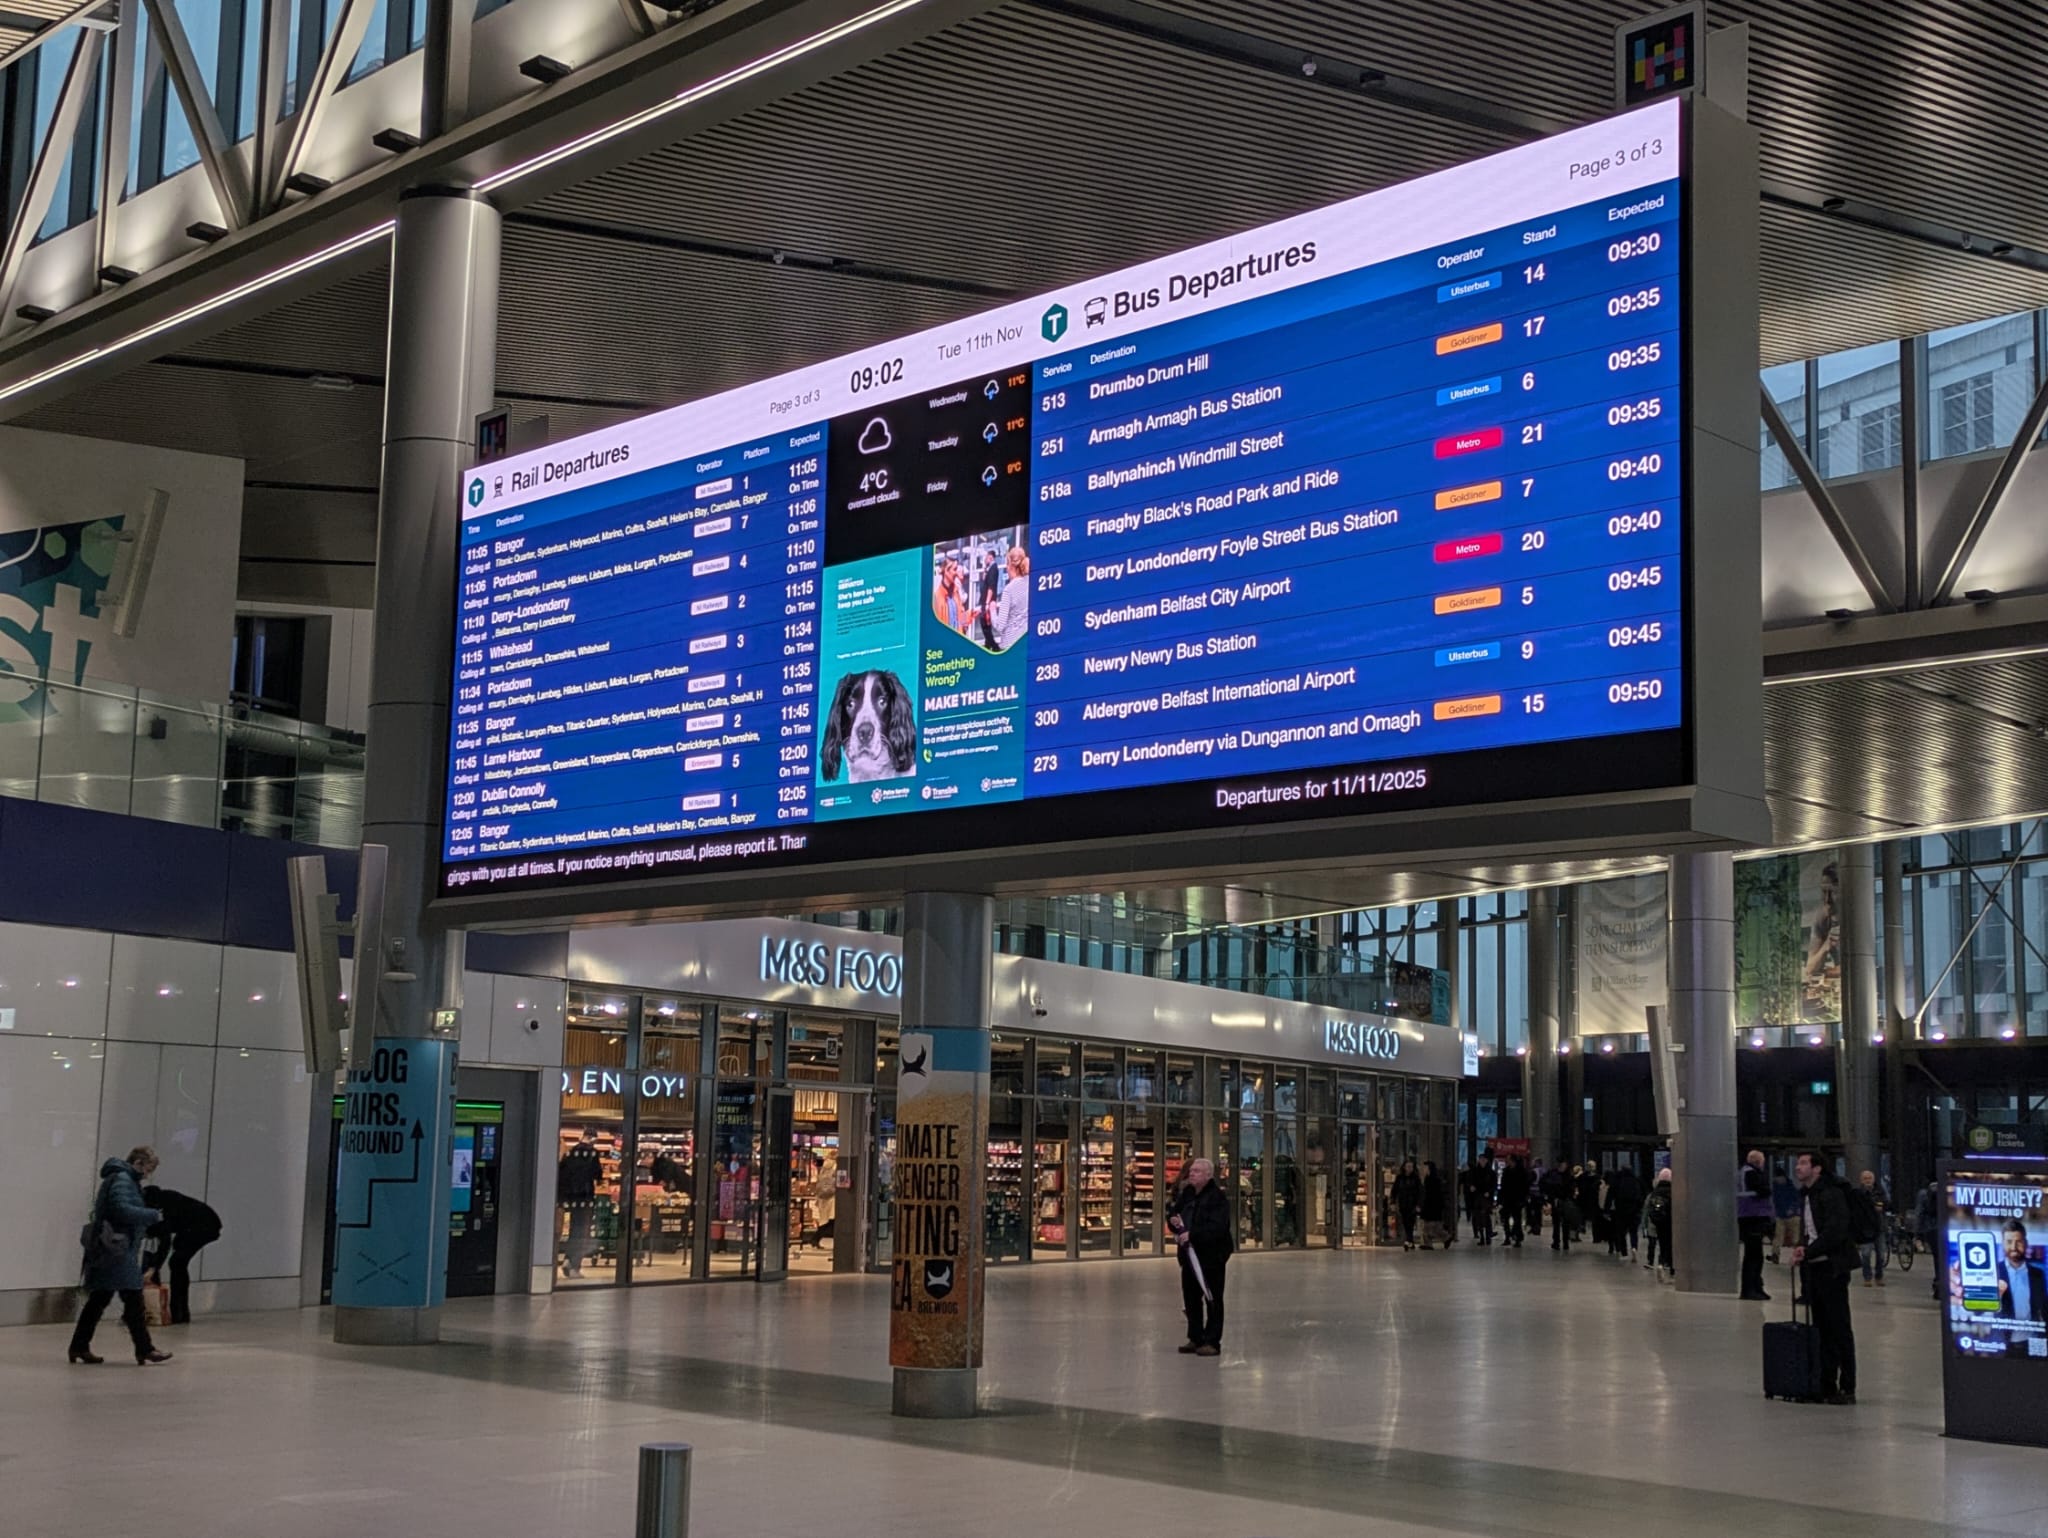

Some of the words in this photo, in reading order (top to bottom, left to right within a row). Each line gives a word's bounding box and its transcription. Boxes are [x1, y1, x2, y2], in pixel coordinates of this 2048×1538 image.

[1570, 158, 1610, 179] Page
[1616, 150, 1625, 166] 3
[1631, 142, 1647, 161] of
[1652, 139, 1661, 155] 3
[1043, 363, 1072, 377] Service
[1090, 345, 1136, 364] Destination
[1437, 248, 1484, 268] Operator
[1523, 225, 1556, 244] Stand
[1609, 195, 1664, 221] Expected
[1114, 288, 1159, 317] Bus
[1169, 242, 1316, 302] Departures
[938, 345, 961, 360] Tue
[966, 332, 993, 352] 11th
[997, 325, 1023, 344] Nov
[1042, 392, 1065, 411] 513
[1090, 374, 1145, 399] Drumbo
[1147, 364, 1183, 384] Drum
[1187, 354, 1208, 373] Hill
[1451, 281, 1489, 296] Ulsterbus
[1524, 263, 1544, 283] 14
[1609, 233, 1660, 262] 09:30
[851, 358, 904, 394] 09:02
[929, 391, 967, 409] Wednesday
[1041, 437, 1063, 456] 251
[1088, 419, 1142, 445] Armagh
[1145, 405, 1197, 431] Armagh
[1201, 400, 1228, 417] Bus
[1231, 386, 1281, 409] Station
[1451, 333, 1487, 347] Goldliner
[1524, 316, 1544, 336] 17
[1608, 287, 1660, 316] 09:35
[770, 400, 792, 413] Page
[795, 395, 800, 407] 3
[803, 391, 812, 404] of
[814, 389, 820, 401] 3
[1041, 482, 1071, 501] 518a
[1088, 457, 1175, 490] Ballynahinch
[1178, 441, 1236, 469] Windmill
[1240, 431, 1283, 455] Street
[1450, 385, 1489, 399] Ulsterbus
[1522, 372, 1534, 390] 6
[1608, 343, 1660, 370] 09:35
[512, 466, 538, 491] Rail
[544, 445, 629, 482] Departures
[928, 436, 959, 451] Thursday
[1039, 527, 1070, 546] 650a
[1087, 513, 1141, 536] Finaghy
[1144, 501, 1192, 524] Black's
[1196, 490, 1233, 513] Road
[1237, 484, 1269, 504] Park
[1272, 476, 1300, 497] and
[1304, 469, 1339, 490] Ride
[1457, 439, 1480, 449] Metro
[1522, 423, 1542, 444] 21
[1608, 398, 1660, 425] 09:35
[495, 538, 524, 554] Bangor
[790, 459, 817, 477] 11:05
[848, 495, 876, 511] overcast
[877, 490, 900, 504] clouds
[927, 481, 948, 494] Friday
[493, 569, 537, 588] Portadown
[789, 499, 816, 517] 11:06
[1038, 573, 1062, 591] 212
[1087, 563, 1124, 581] Derry
[1127, 545, 1217, 574] Londonderry
[1221, 535, 1259, 556] Foyle
[1262, 525, 1305, 547] Street
[1310, 521, 1339, 538] Bus
[1343, 510, 1397, 531] Station
[1450, 490, 1486, 503] Goldliner
[1522, 478, 1533, 497] 7
[1608, 454, 1660, 480] 09:40
[491, 598, 570, 624] Derry-Londonderry
[787, 539, 814, 557] 11:10
[1037, 618, 1060, 636] 600
[1085, 604, 1157, 629] Sydenham
[1161, 592, 1207, 614] Belfast
[1210, 588, 1238, 606] City
[1241, 577, 1291, 600] Airport
[1456, 544, 1480, 554] Metro
[1522, 531, 1544, 551] 20
[1608, 510, 1660, 535] 09:40
[490, 639, 533, 659] Whitehead
[786, 580, 813, 598] 11:15
[1036, 663, 1059, 681] 238
[1085, 656, 1128, 674] Newry
[1131, 649, 1173, 666] Newry
[1177, 643, 1203, 659] Bus
[1206, 634, 1256, 654] Station
[1449, 597, 1486, 608] Goldliner
[1522, 586, 1533, 605] 5
[1608, 566, 1661, 591] 09:45
[926, 650, 943, 661] See
[926, 657, 975, 675] Something
[926, 673, 961, 688] Wrong?
[1035, 709, 1058, 726] 300
[1083, 698, 1159, 720] Aldergrove
[1162, 688, 1208, 709] Belfast
[1213, 674, 1299, 702] International
[1303, 667, 1355, 690] Airport
[1449, 650, 1488, 661] Ulsterbus
[1522, 641, 1533, 659] 9
[1609, 622, 1661, 647] 09:45
[924, 695, 958, 712] MAKE
[961, 690, 985, 706] THE
[986, 684, 1019, 702] CALL
[1034, 755, 1057, 772] 273
[1082, 751, 1120, 766] Derry
[1123, 739, 1214, 761] Londonderry
[1217, 733, 1237, 750] via
[1241, 725, 1325, 747] Dungannon
[1329, 717, 1358, 737] and
[1363, 710, 1420, 732] Omagh
[1449, 704, 1485, 714] Goldliner
[1523, 694, 1544, 713] 15
[1609, 679, 1661, 703] 09:50
[483, 753, 507, 766] Larne
[508, 748, 542, 762] Harbour
[782, 703, 809, 720] 11:45
[481, 787, 508, 802] Dublin
[509, 782, 546, 798] Connolly
[780, 744, 807, 761] 12:00
[1217, 786, 1301, 809] Departures
[1305, 781, 1327, 798] for
[1333, 769, 1426, 795] 11/11/2025
[448, 870, 470, 886] gings
[471, 867, 489, 880] with
[490, 868, 506, 882] you
[507, 864, 517, 877] at
[518, 862, 528, 876] all
[530, 862, 556, 875] times.
[557, 858, 565, 872] If
[565, 860, 583, 874] you
[584, 855, 613, 869] notice
[614, 850, 654, 868] anything
[656, 845, 696, 862] unusual,
[699, 843, 732, 861] please
[734, 838, 765, 857] report
[767, 837, 777, 851] it.
[761, 935, 830, 987] M&S
[834, 946, 903, 997] FOO
[1325, 1019, 1357, 1055] M&S
[1359, 1024, 1400, 1060] FOOD
[1955, 1186, 1977, 1205] MY
[1978, 1187, 2043, 1208] JOURNEY?
